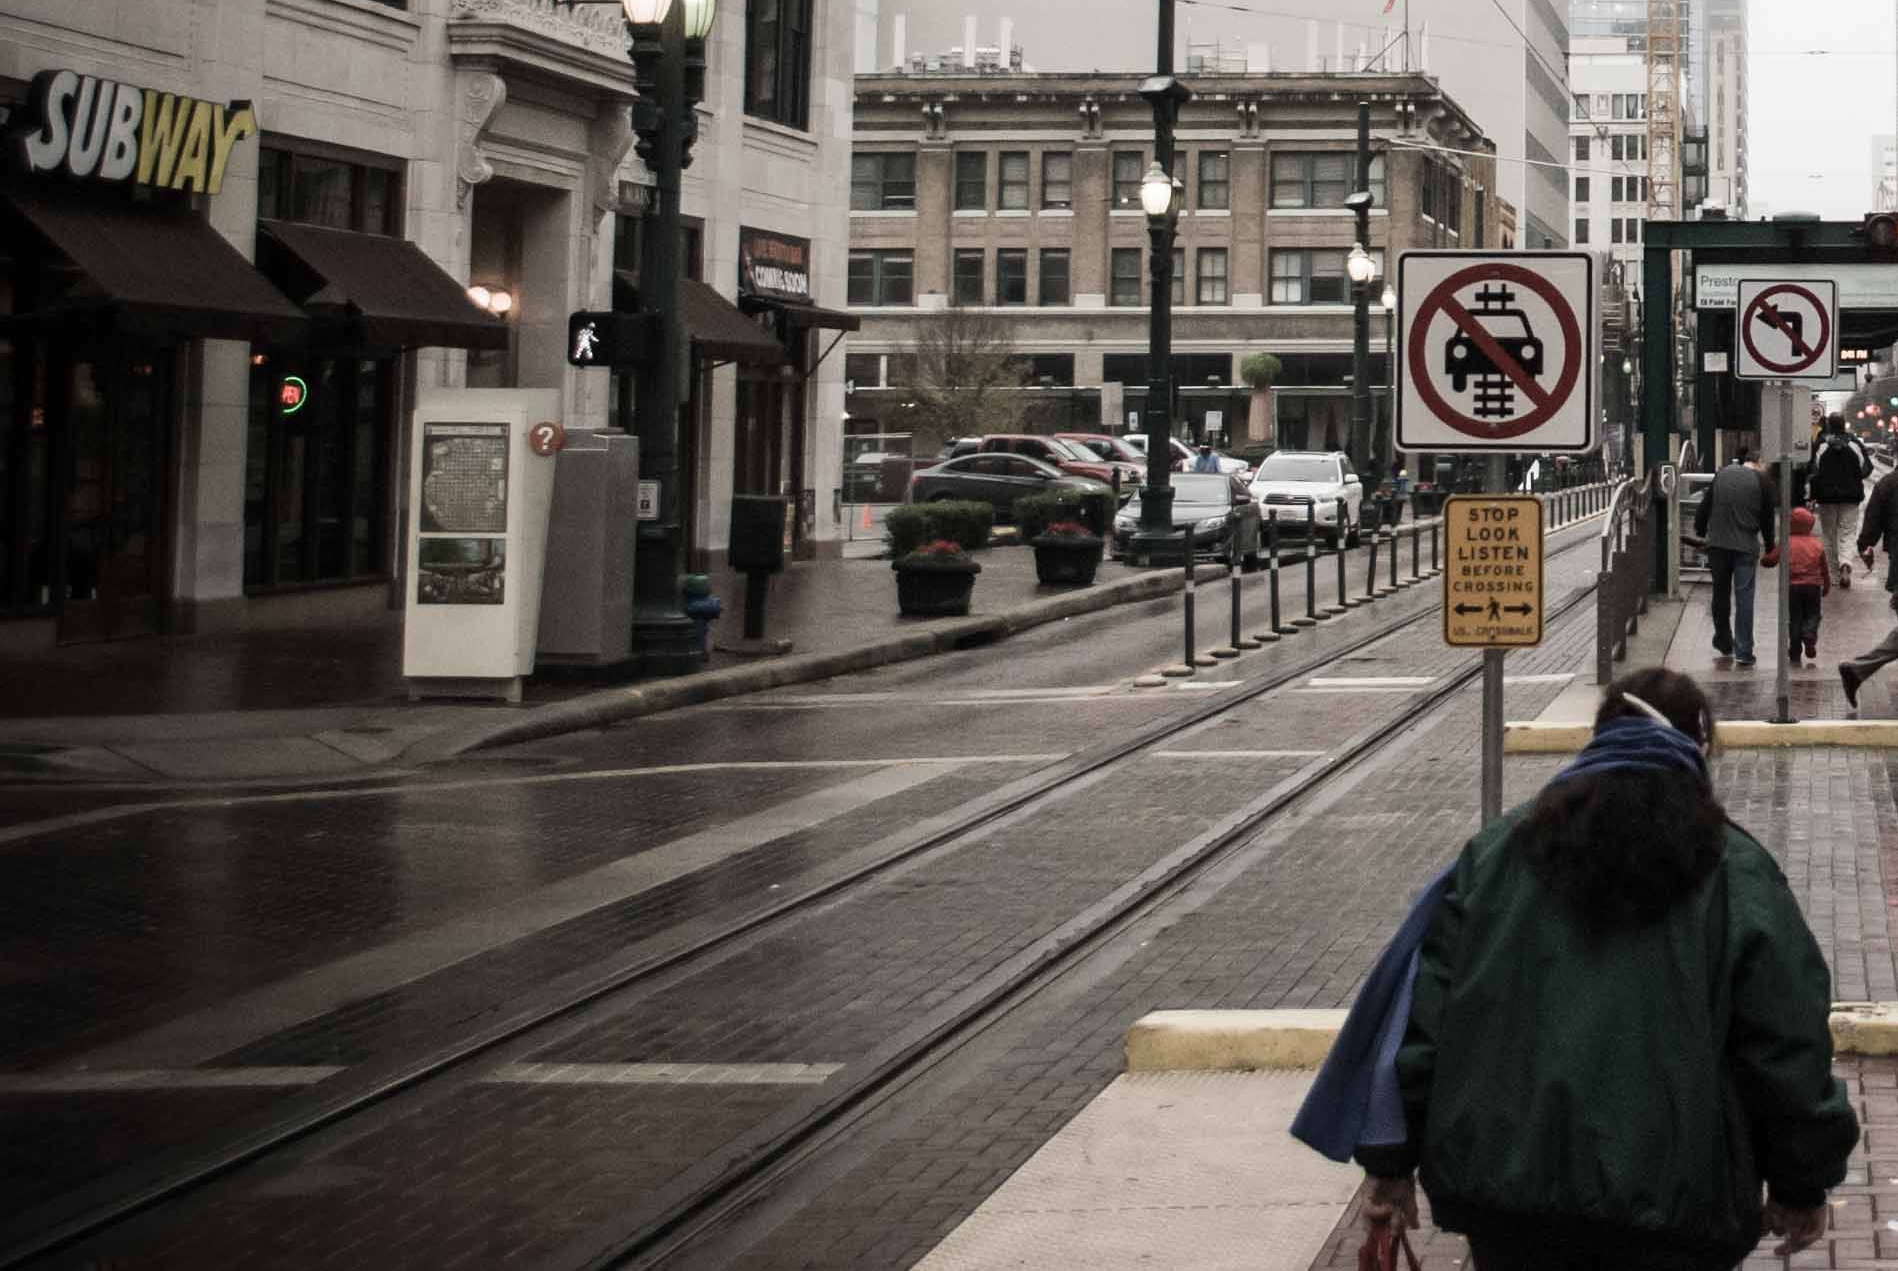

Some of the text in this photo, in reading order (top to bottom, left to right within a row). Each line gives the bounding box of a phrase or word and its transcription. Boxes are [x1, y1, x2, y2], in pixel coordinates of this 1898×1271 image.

[25, 69, 257, 195] SUBWAY
[755, 265, 807, 294] COMING SOON
[1468, 508, 1519, 522] STOP
[1466, 527, 1520, 541] LOOK
[1458, 546, 1528, 560] LISTEN
[1461, 565, 1524, 576] BEFORE
[1453, 581, 1533, 593] CROSSING
